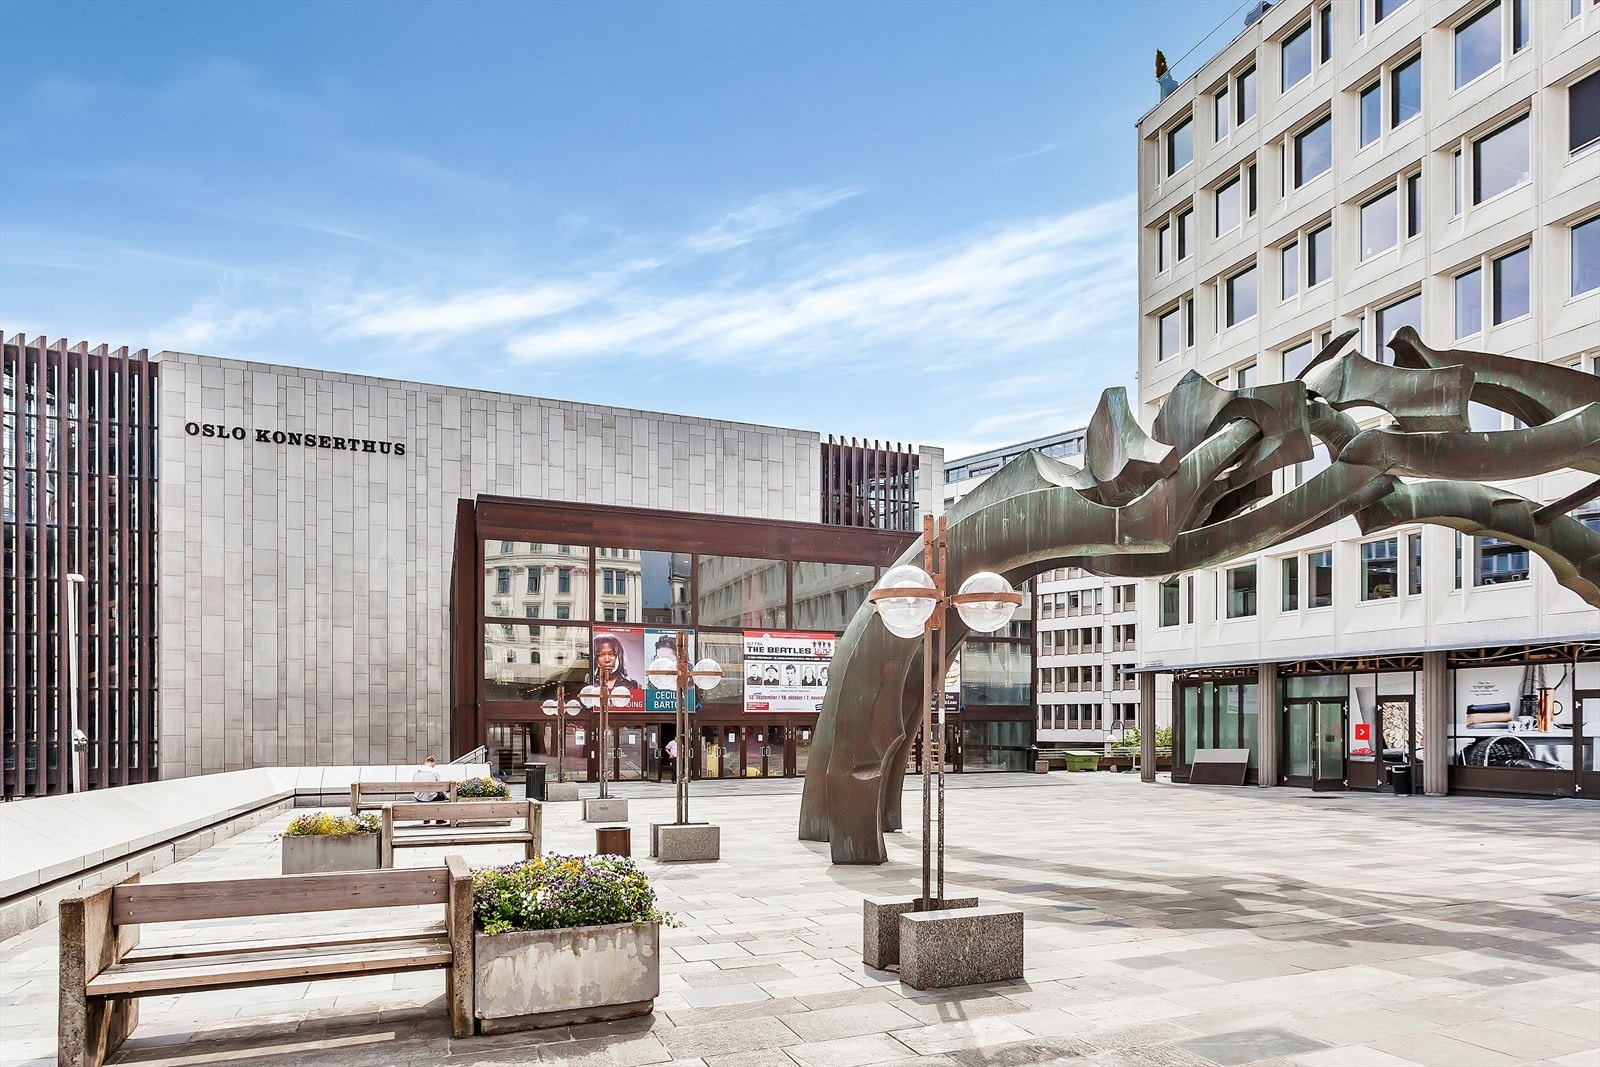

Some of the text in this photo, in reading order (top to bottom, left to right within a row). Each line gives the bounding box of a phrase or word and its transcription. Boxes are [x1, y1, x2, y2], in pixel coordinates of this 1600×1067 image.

[184, 421, 406, 456] OSLO KONSERTHUS
[767, 646, 812, 654] BEATLES
[655, 691, 685, 700] CECILA
